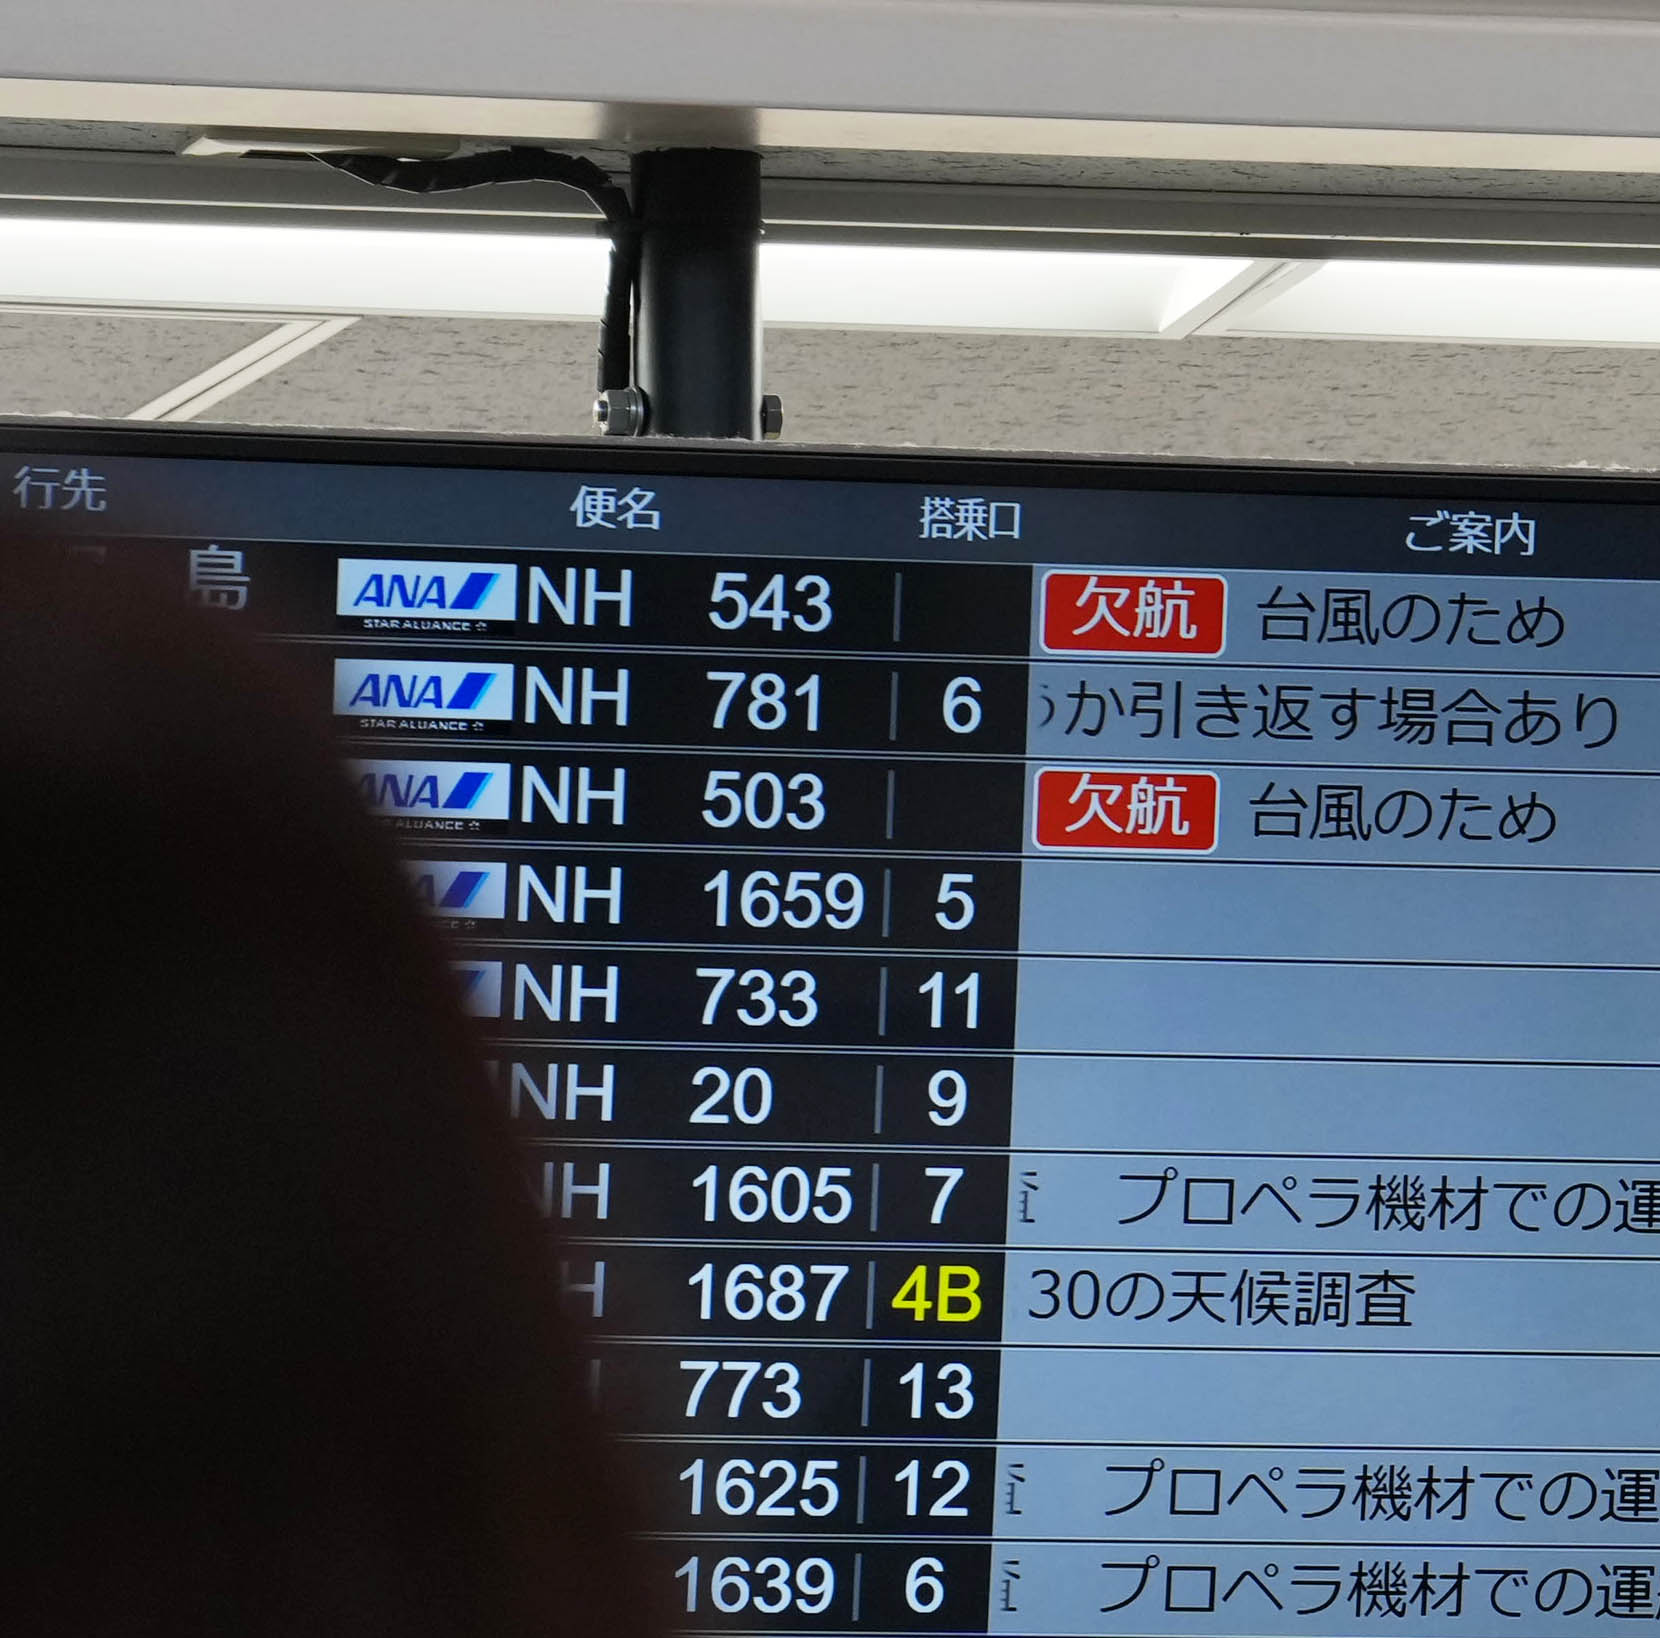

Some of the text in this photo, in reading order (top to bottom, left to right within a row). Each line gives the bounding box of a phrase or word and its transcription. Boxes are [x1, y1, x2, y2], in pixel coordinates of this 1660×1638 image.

[12, 465, 107, 511] 行先
[569, 485, 660, 530] 便名
[919, 496, 1021, 542] 搭乗口
[1405, 509, 1536, 556] ご案内
[353, 574, 446, 608] ANA
[527, 566, 632, 627] NH
[708, 572, 833, 633] 543
[1072, 575, 1198, 639] 欠航
[1256, 585, 1565, 649] 台風のため
[350, 673, 443, 709] ANA
[524, 665, 629, 727] NH
[706, 671, 820, 732] 781
[942, 676, 982, 734] 6
[521, 765, 626, 825] NH
[701, 770, 825, 830] 503
[1064, 772, 1190, 836] 欠航
[1248, 781, 1557, 844] 台風のため
[517, 864, 975, 931] NH 1659 5
[513, 963, 979, 1029] NH 733 11
[510, 1063, 967, 1127] NH 20 9
[692, 1164, 852, 1224] 1605
[924, 1167, 964, 1224] 7
[688, 1263, 1416, 1328] 1687 4B 30の天候調査
[679, 1360, 974, 1420] 773 13
[679, 1458, 839, 1517] 1625
[894, 1459, 970, 1517] 12
[675, 1556, 835, 1614] 1639
[905, 1556, 944, 1613] 6
